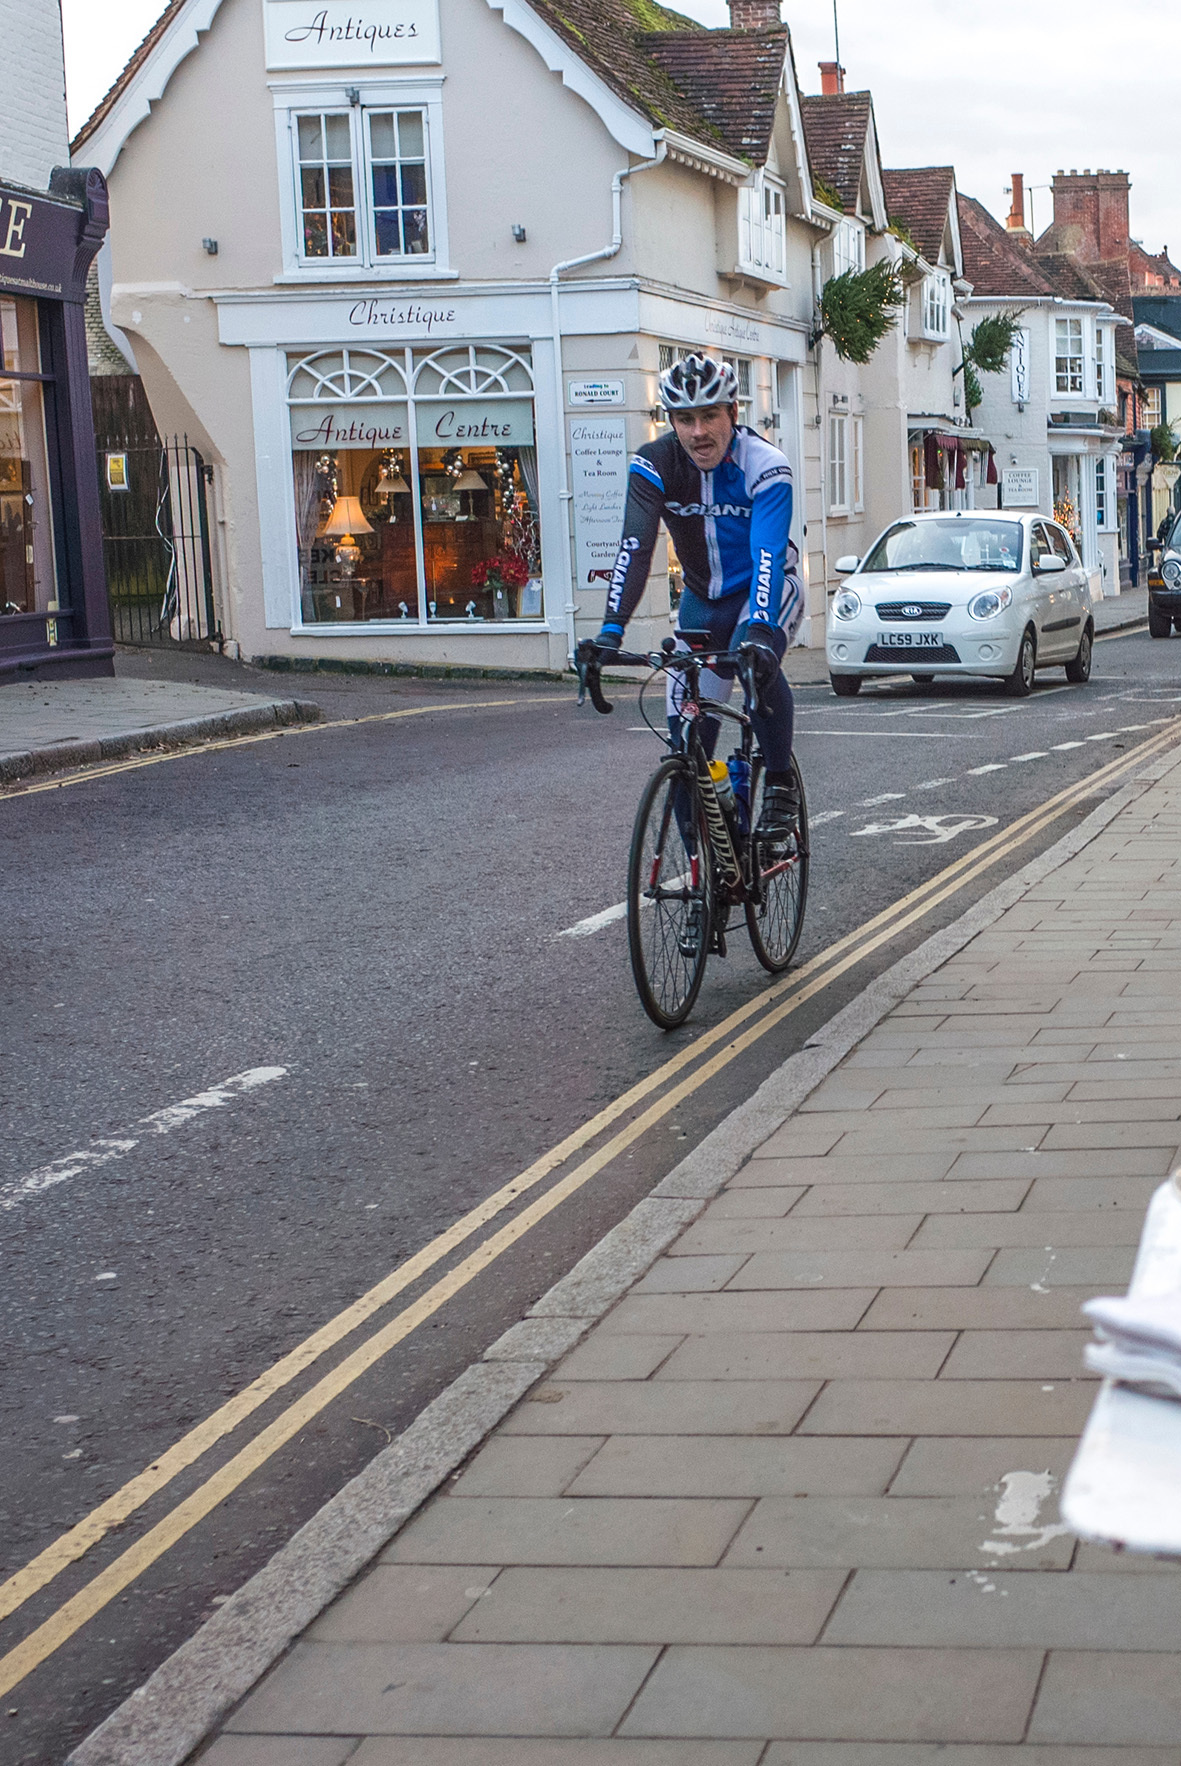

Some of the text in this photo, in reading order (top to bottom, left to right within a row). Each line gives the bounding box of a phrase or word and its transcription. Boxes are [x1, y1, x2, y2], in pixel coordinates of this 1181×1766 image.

[284, 10, 419, 53] Antiques
[0, 197, 33, 258] E
[349, 299, 456, 333] Christique
[296, 411, 512, 449] Antique Centre
[572, 427, 624, 443] Christique
[575, 448, 623, 457] Coffee Lounge
[586, 540, 620, 549] Courtyard
[609, 551, 631, 613] GIANT
[756, 549, 772, 608] GIANT
[881, 634, 939, 645] LC59 JXK
